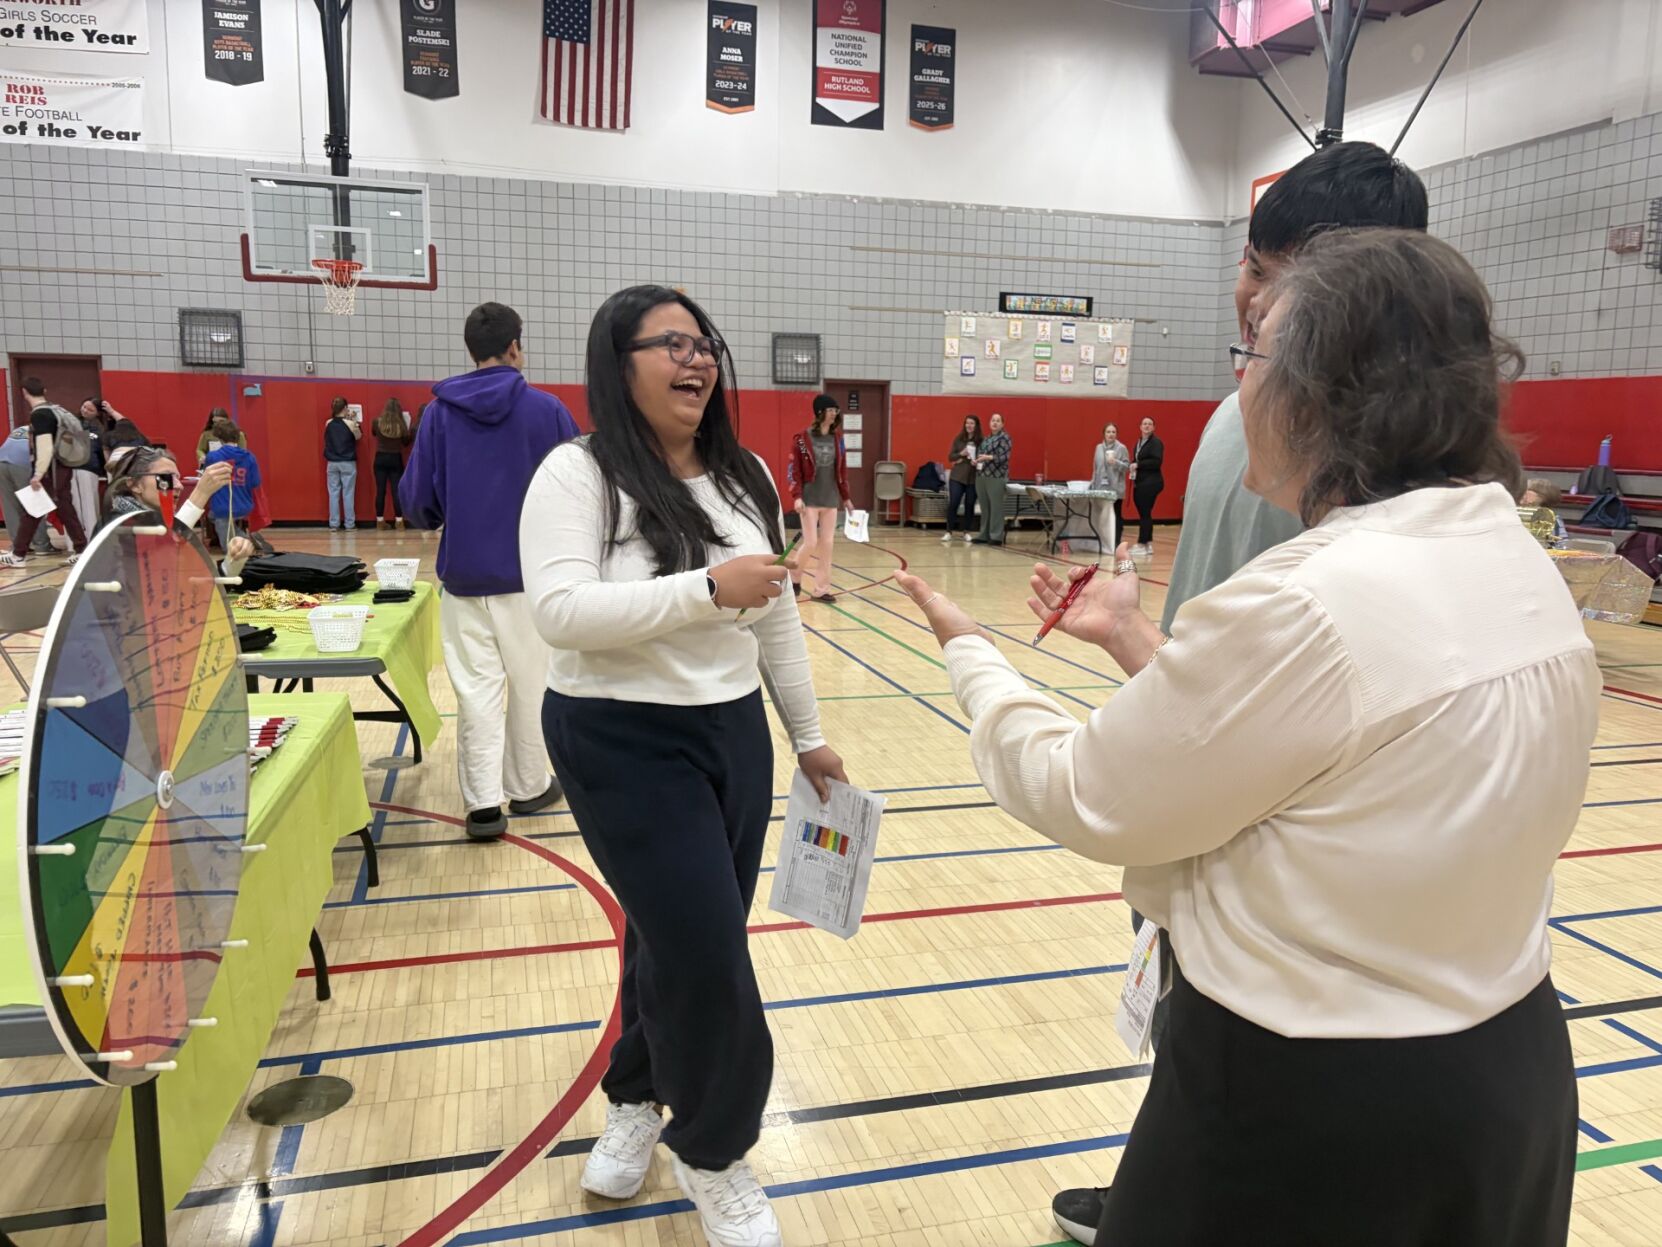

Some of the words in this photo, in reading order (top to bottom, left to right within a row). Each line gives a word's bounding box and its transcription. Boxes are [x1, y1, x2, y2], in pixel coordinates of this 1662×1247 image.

[41, 10, 97, 25] SOCCER
[218, 20, 245, 29] EVANS
[712, 18, 752, 32] PLYER
[0, 24, 25, 39] of
[33, 26, 75, 42] the
[81, 29, 137, 46] Year
[416, 29, 441, 37] SLADE
[831, 33, 867, 43] NATIONAL
[722, 47, 742, 55] ANNA
[834, 42, 863, 51] UNIFIED
[915, 43, 952, 54] PLYER
[214, 50, 235, 60] 2018
[242, 52, 253, 61] 19
[720, 54, 743, 62] MOSER
[829, 49, 868, 59] CHAMPION
[834, 57, 863, 67] SCHOOL
[412, 66, 431, 76] 2021
[438, 68, 449, 77] 22
[715, 80, 747, 90] 2023-24
[831, 76, 864, 85] RUTLAND
[6, 83, 45, 95] ROB
[824, 81, 842, 91] HIGH
[843, 84, 871, 94] SCHOOL
[5, 94, 48, 106] REIS
[15, 106, 83, 122] FOOTBALL
[3, 121, 28, 136] of
[37, 123, 77, 139] the
[86, 125, 142, 142] Year
